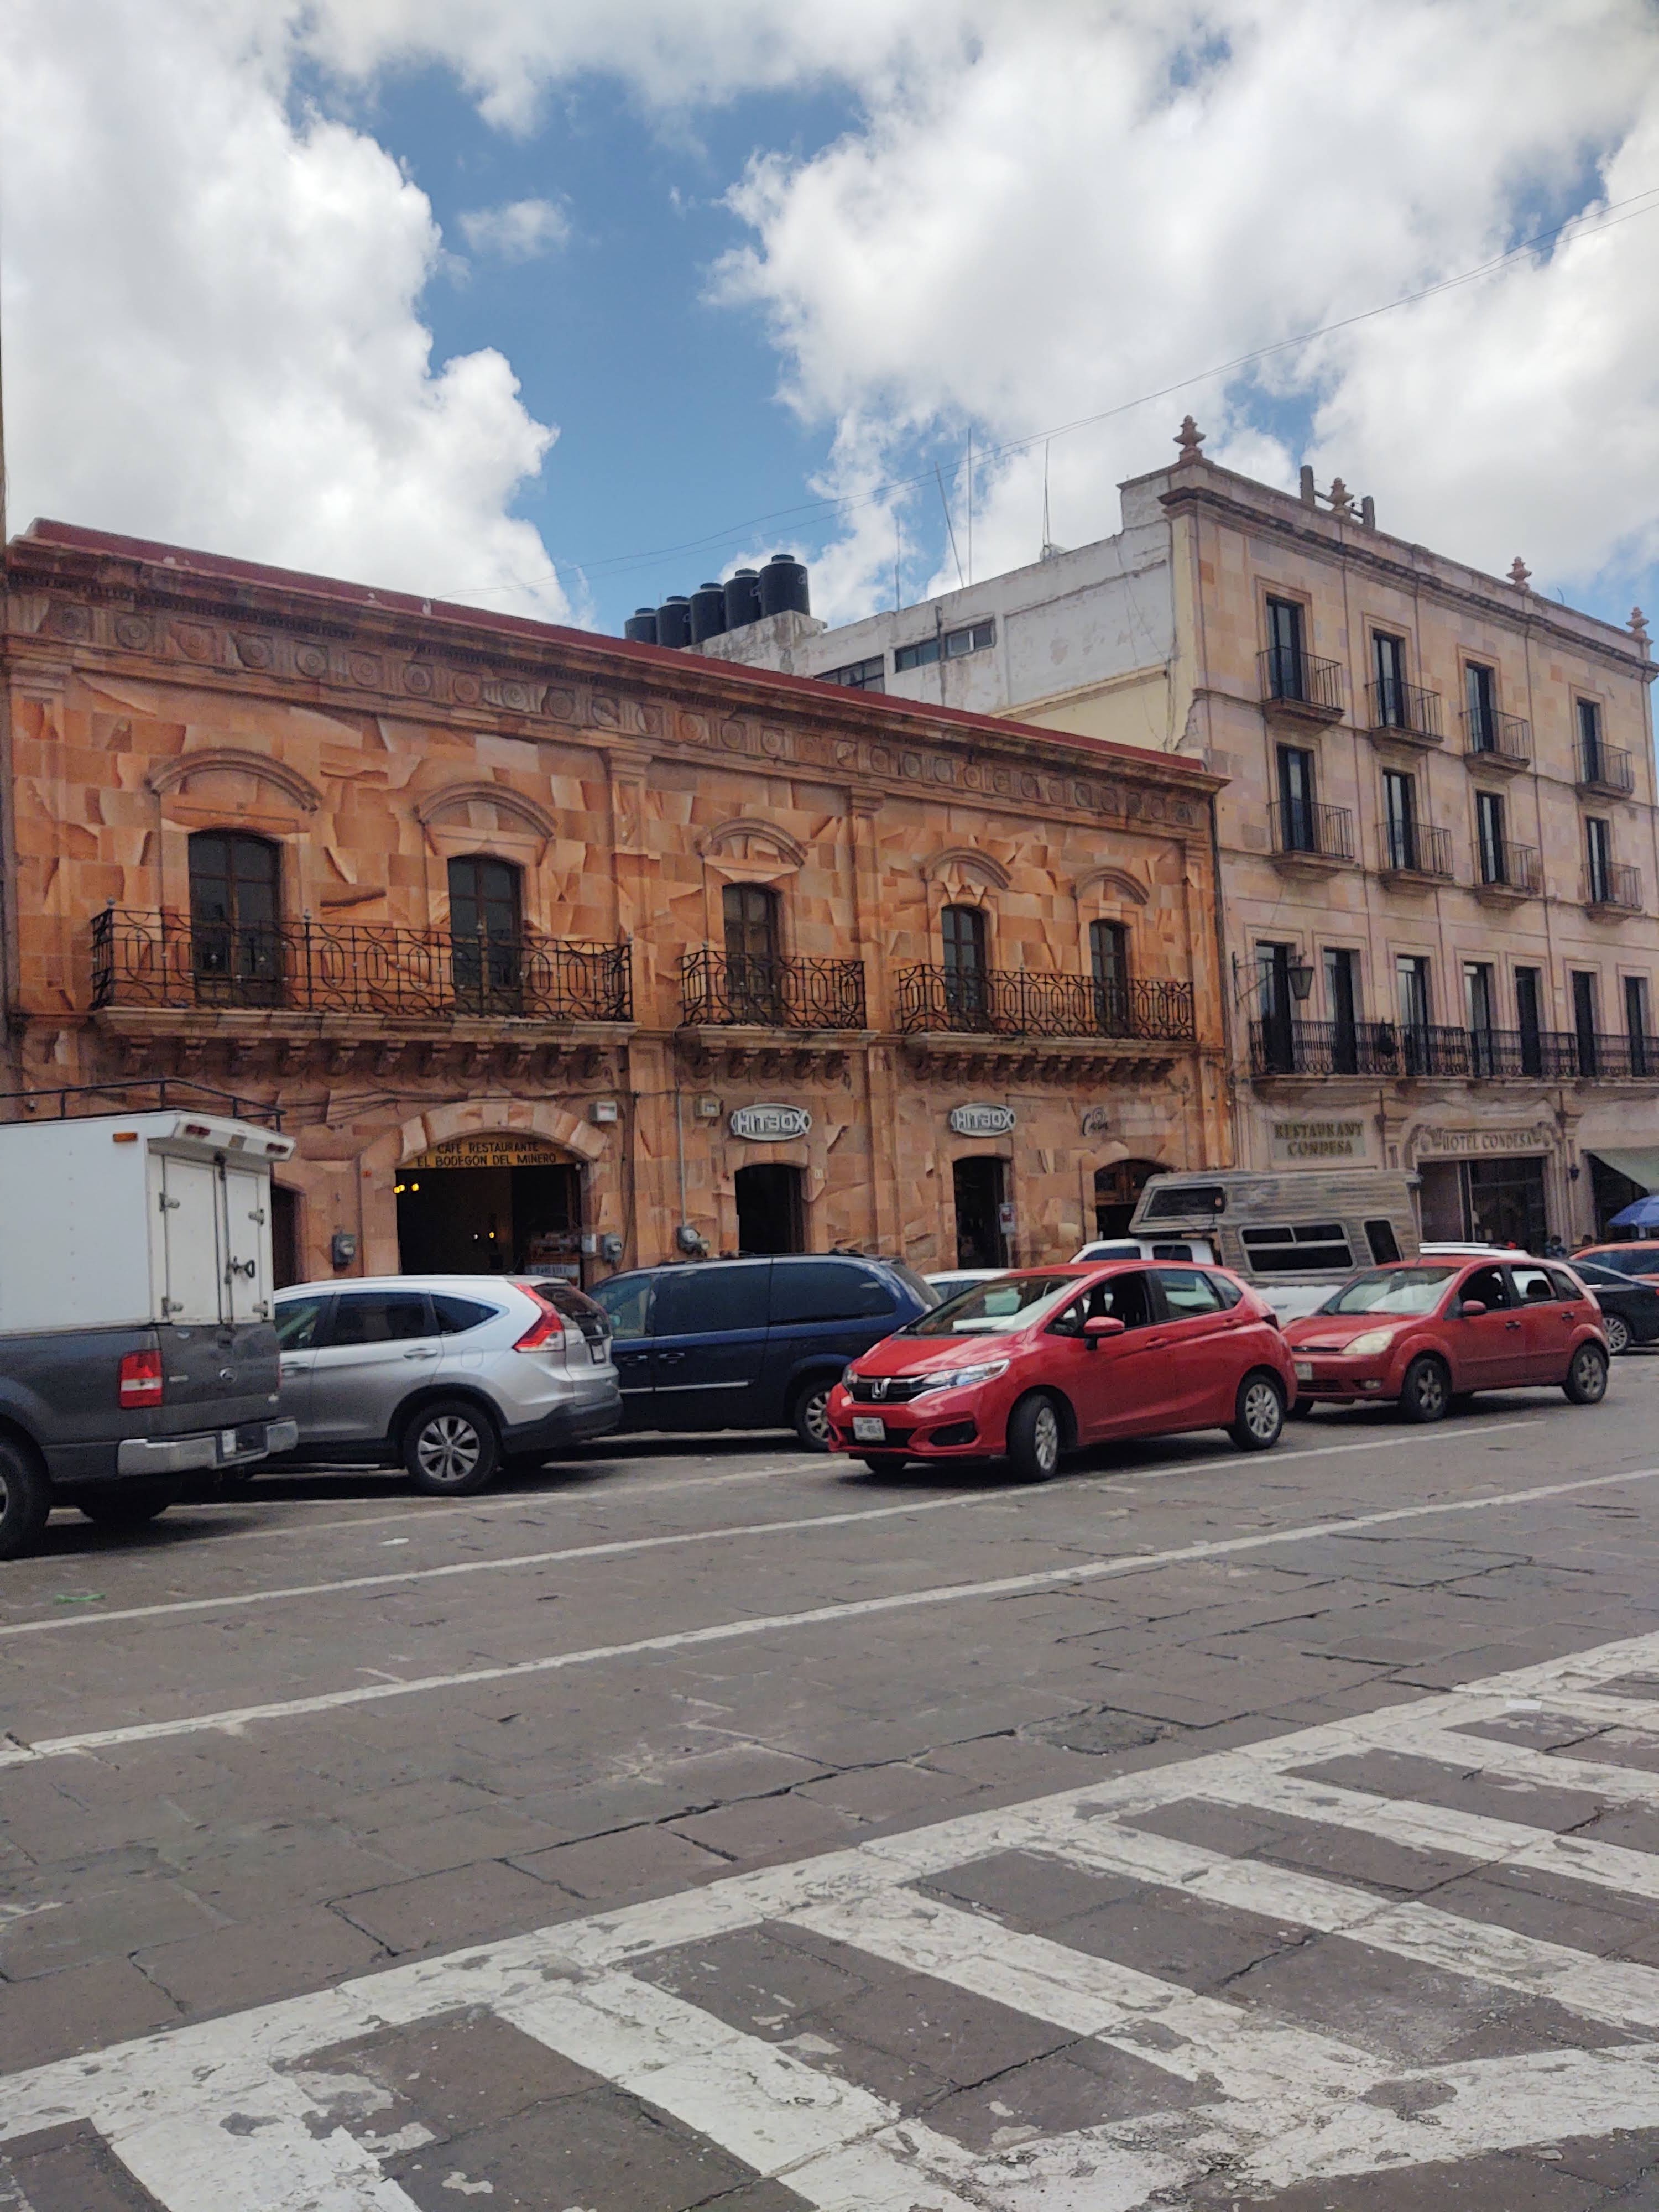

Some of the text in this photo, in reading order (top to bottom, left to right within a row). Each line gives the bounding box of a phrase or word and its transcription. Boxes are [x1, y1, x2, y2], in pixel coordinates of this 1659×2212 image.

[736, 1109, 808, 1134] HITBOX
[956, 1108, 1014, 1130] HITBOX
[1274, 1120, 1363, 1139] RESTAURANT
[468, 1141, 538, 1153] RESTAURANTE
[1287, 1140, 1353, 1156] CONDESA
[1443, 1133, 1532, 1151] HOTEL CONDESA
[418, 1152, 556, 1167] EL BODEGON DEL MINERO
